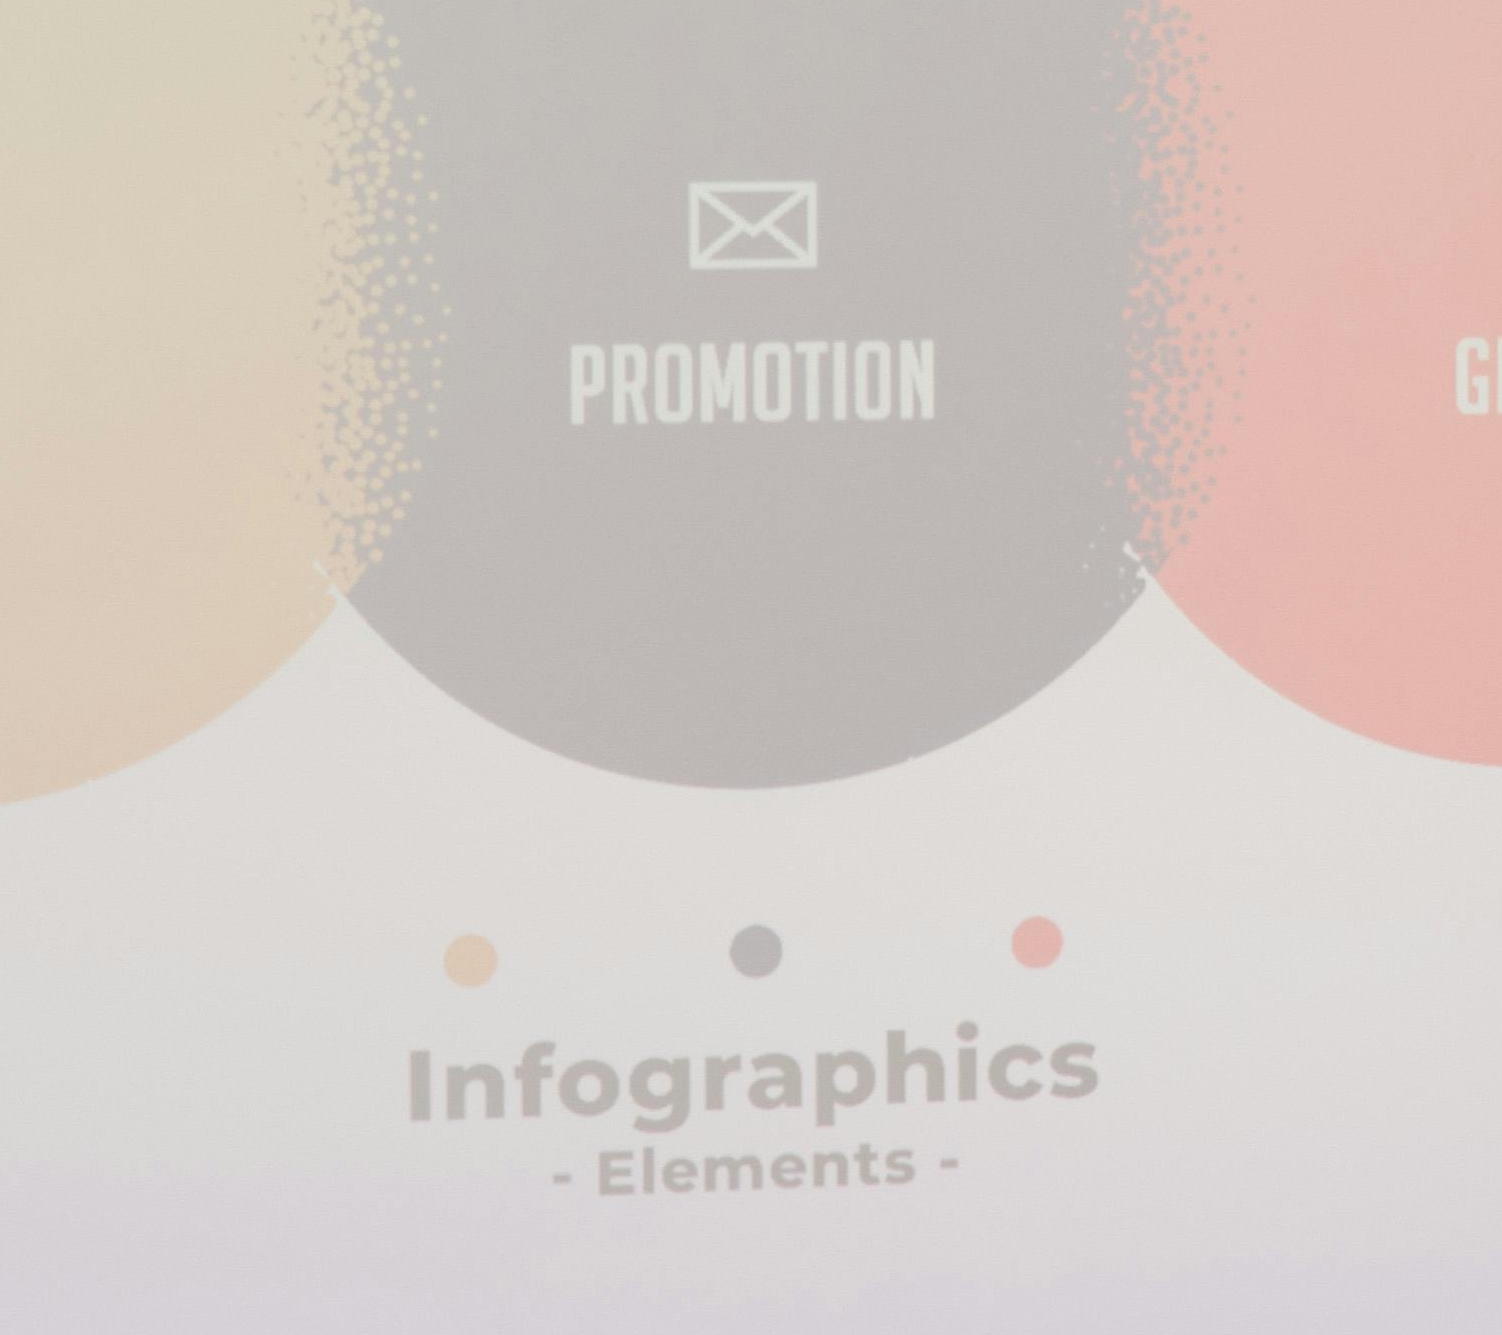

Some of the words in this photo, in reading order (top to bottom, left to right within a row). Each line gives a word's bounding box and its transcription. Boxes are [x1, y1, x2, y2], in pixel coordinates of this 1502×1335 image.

[570, 339, 936, 425] PROMOTION
[409, 1021, 1099, 1134] Infographics
[598, 1142, 916, 1196] Elements
